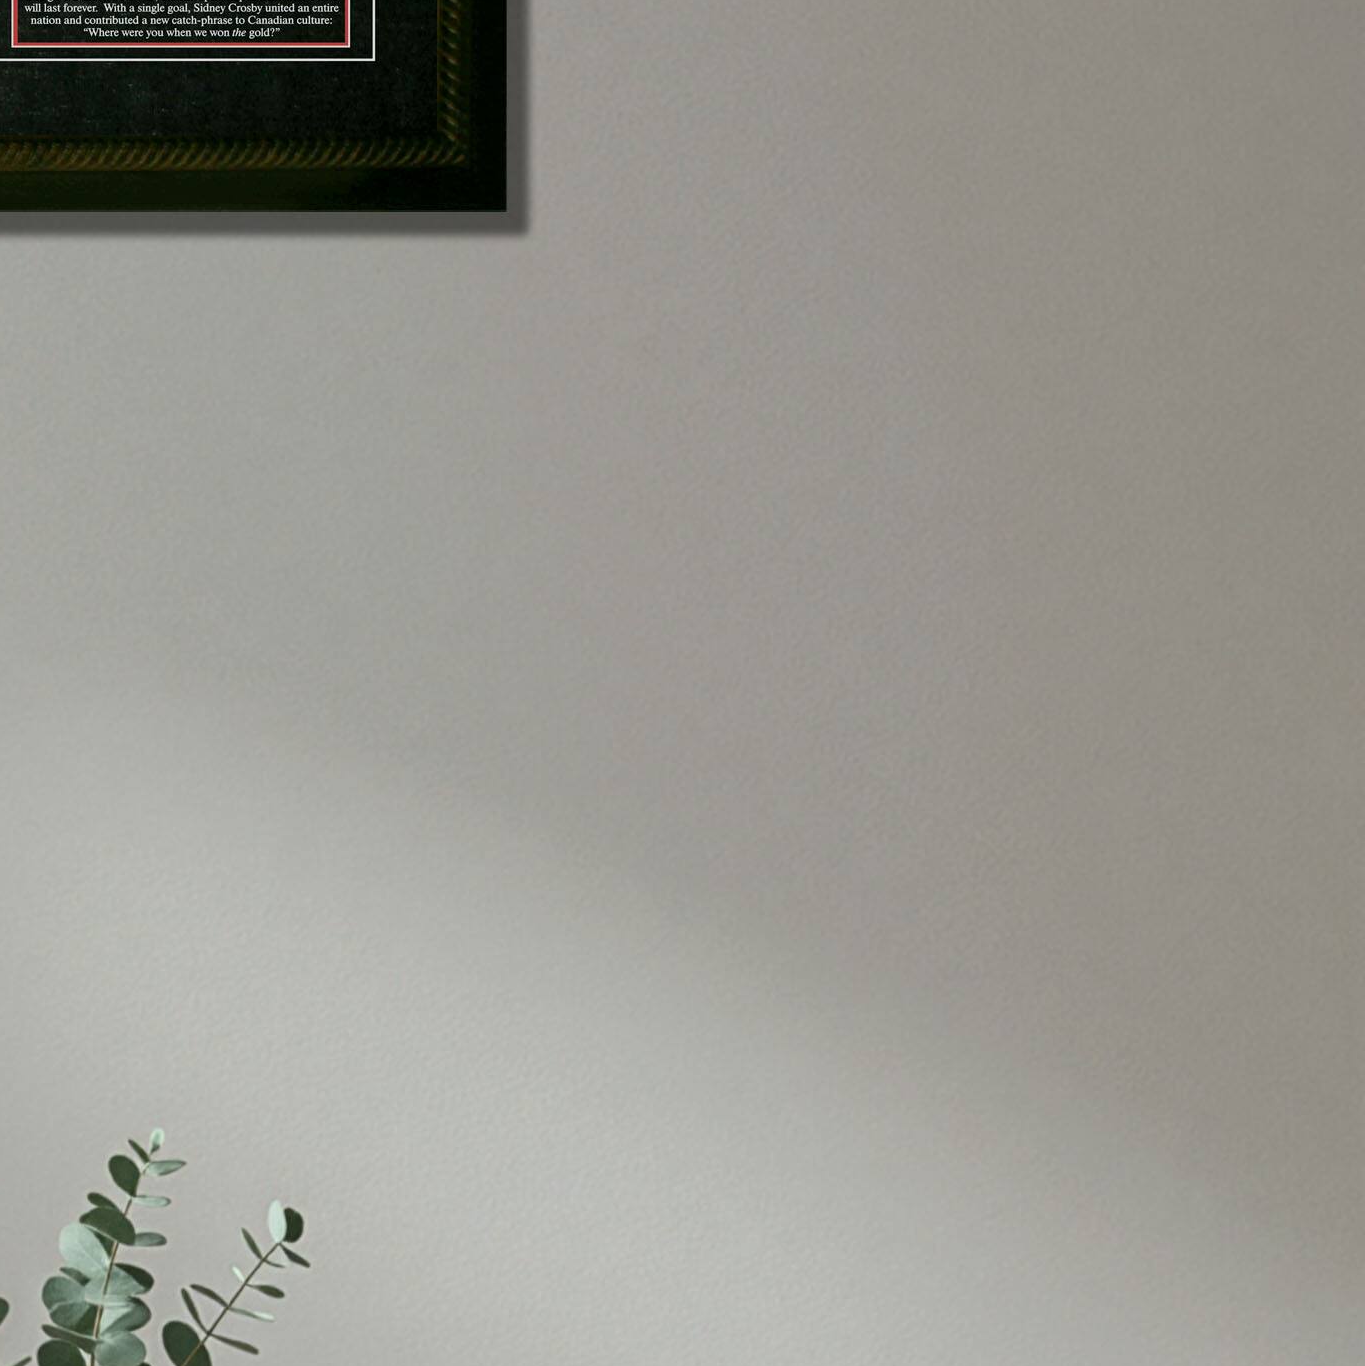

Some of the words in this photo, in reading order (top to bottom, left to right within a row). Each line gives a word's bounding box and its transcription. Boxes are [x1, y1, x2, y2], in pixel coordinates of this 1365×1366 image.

[31, 15, 61, 24] nation
[64, 15, 82, 24] and
[85, 15, 139, 24] contributed
[172, 15, 233, 27] catch-phrase
[248, 15, 294, 24] Canadian
[297, 15, 332, 24] culture:
[84, 28, 119, 37] “Where
[146, 30, 164, 39] you
[167, 28, 191, 37] when
[232, 28, 247, 37] the
[249, 28, 280, 39] gold?”
